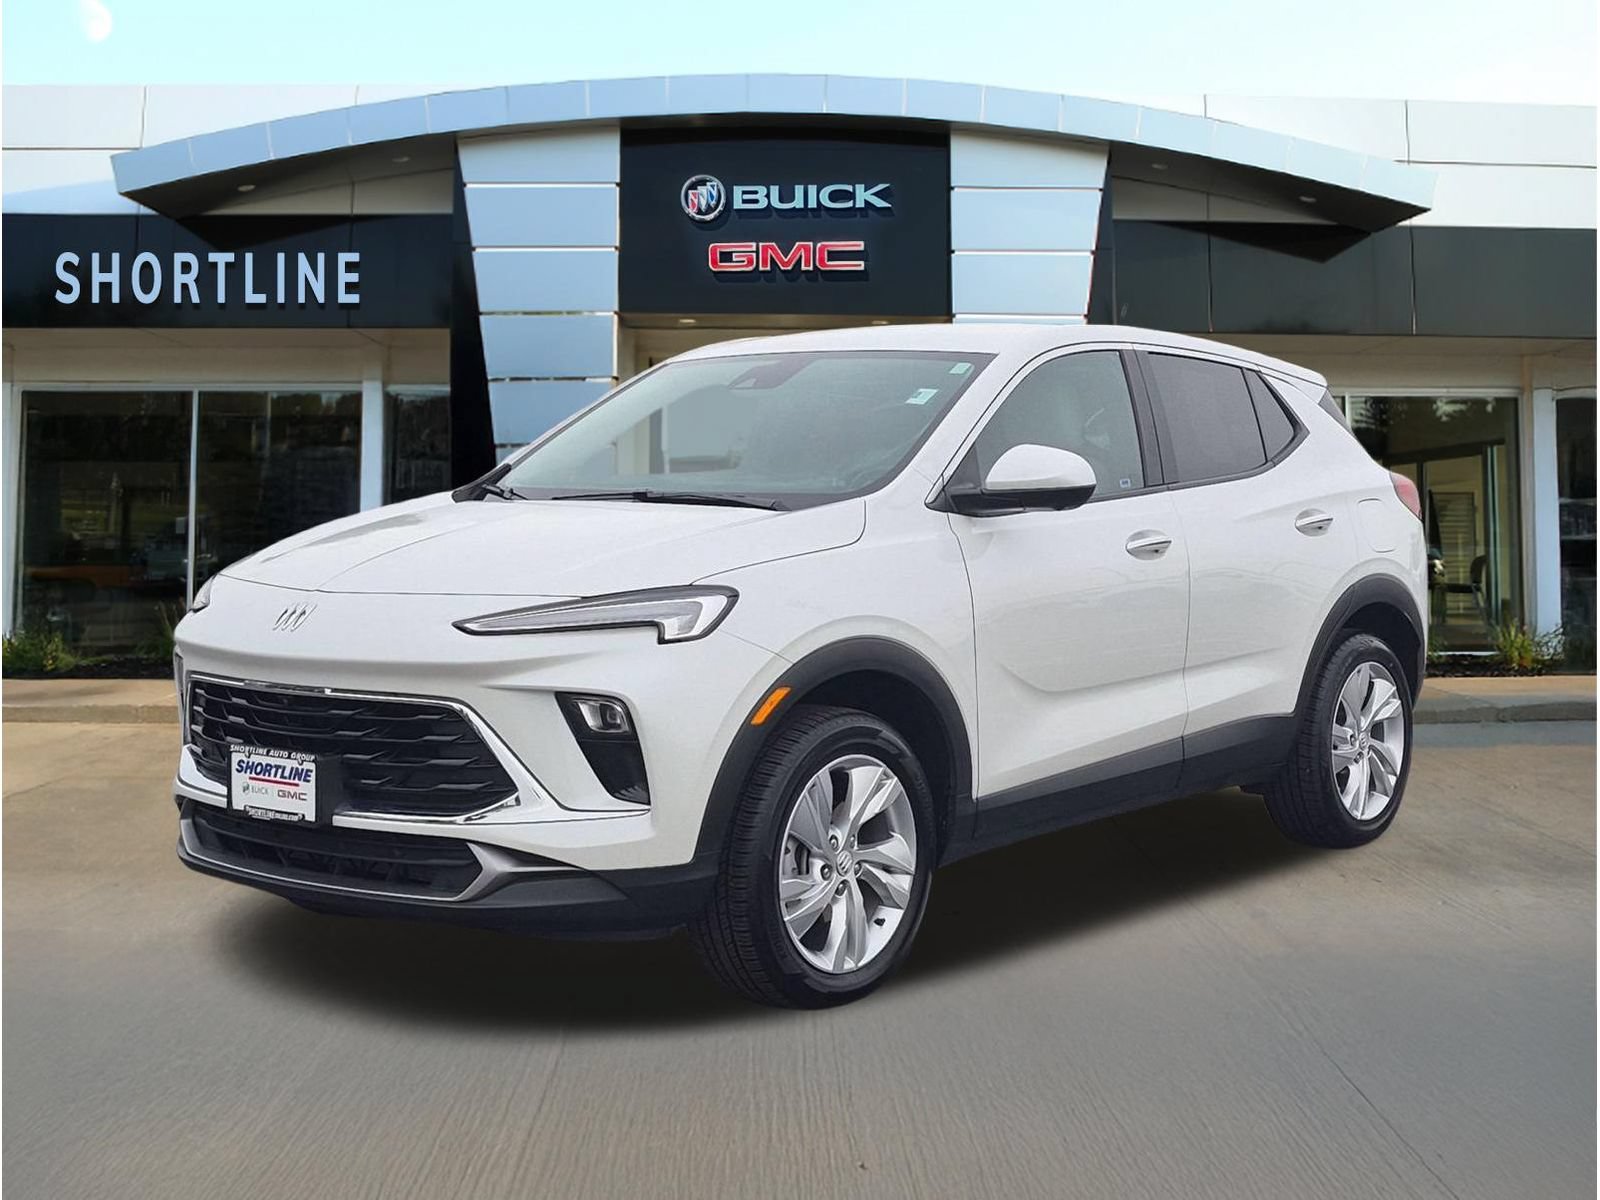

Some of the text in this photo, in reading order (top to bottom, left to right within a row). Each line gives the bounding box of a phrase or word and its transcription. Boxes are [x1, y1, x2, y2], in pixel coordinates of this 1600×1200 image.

[732, 183, 892, 210] BUICK
[708, 240, 865, 271] GMC
[54, 251, 361, 304] SHORTLINE
[230, 744, 315, 762] SHORTLINE AUTO GROUP
[235, 759, 313, 783] SHORTLINE
[277, 789, 307, 801] GMC
